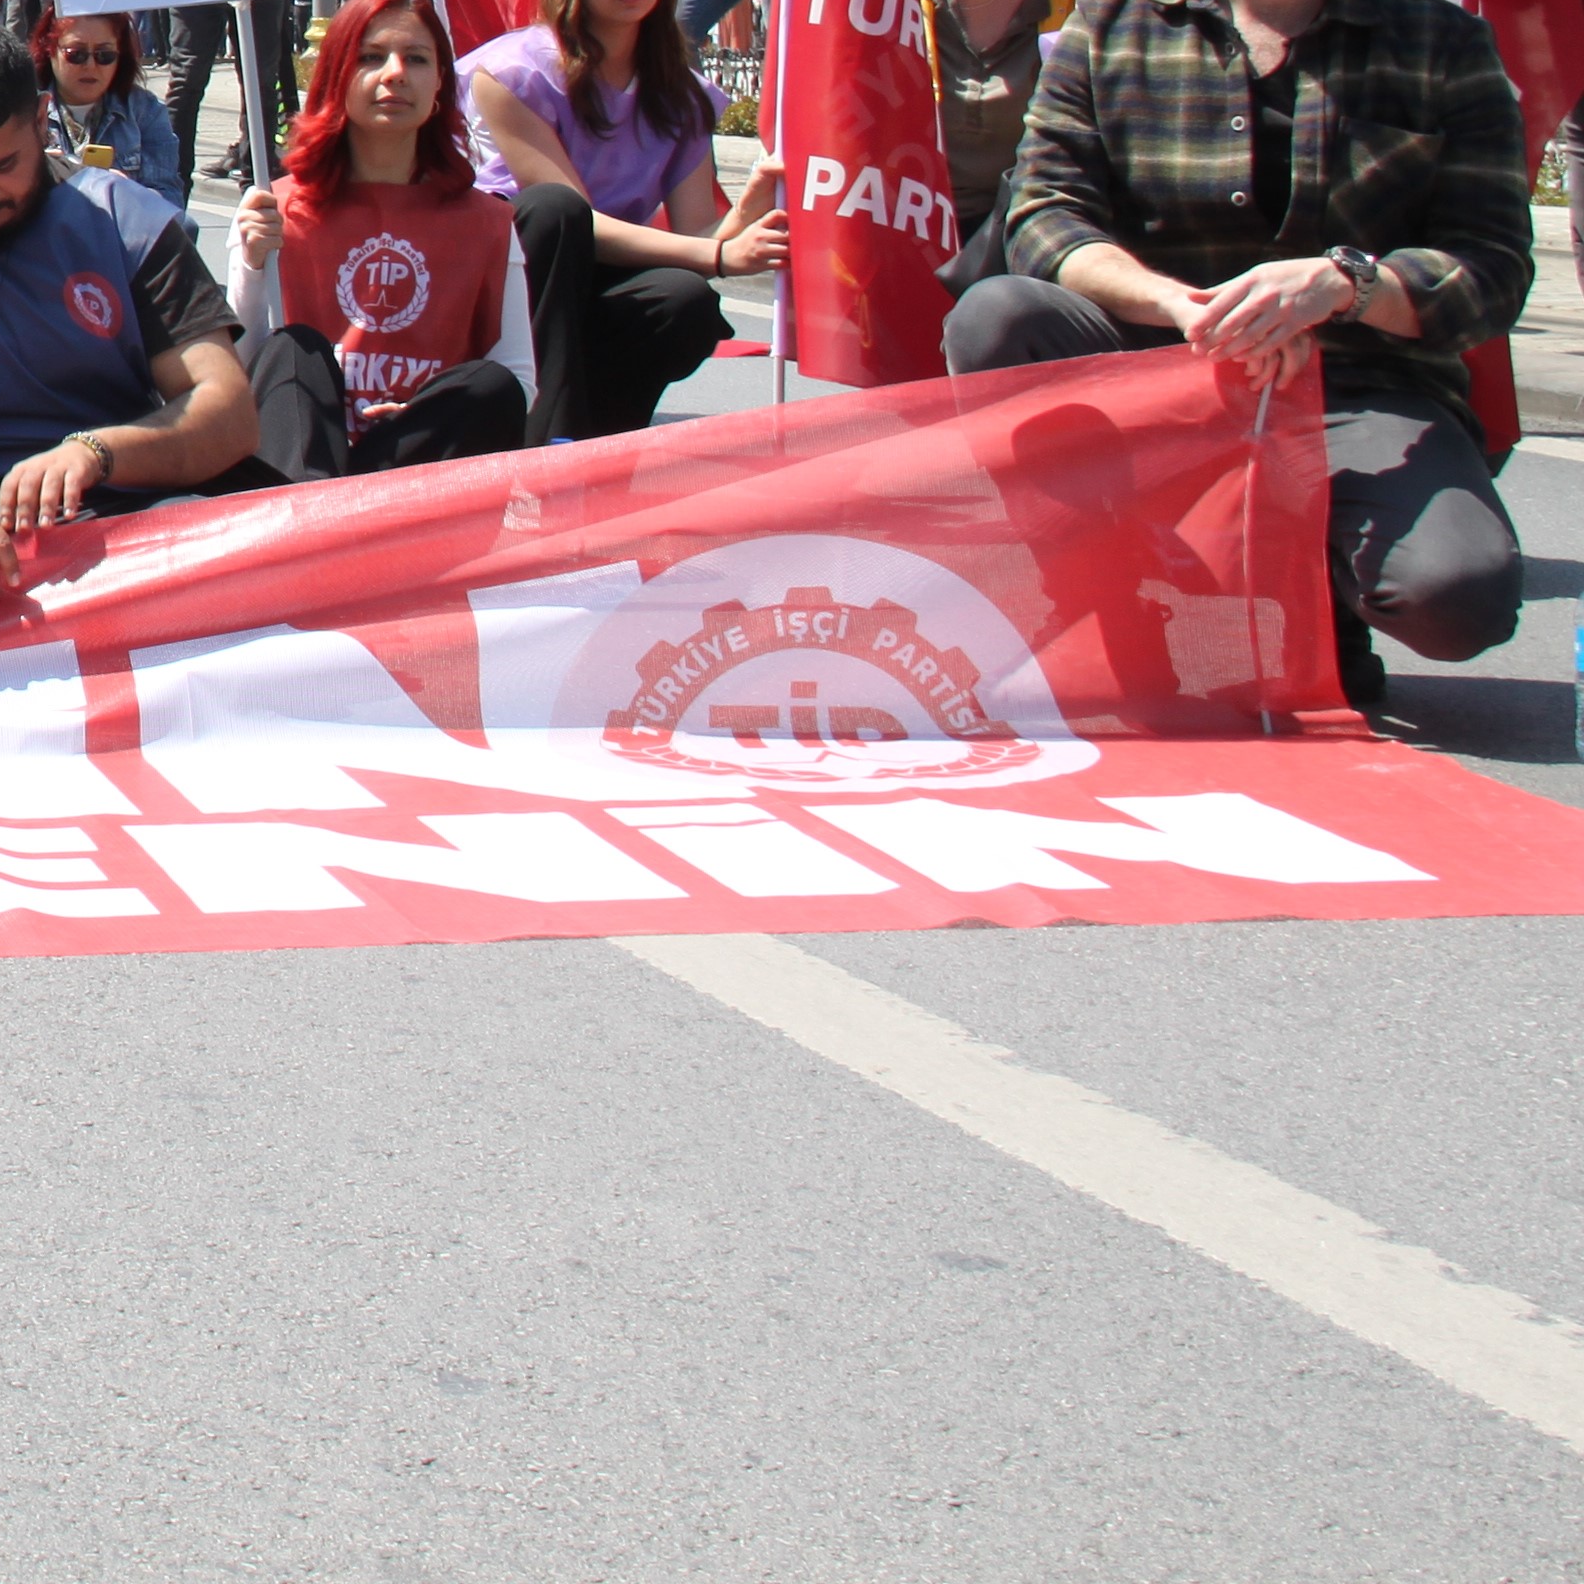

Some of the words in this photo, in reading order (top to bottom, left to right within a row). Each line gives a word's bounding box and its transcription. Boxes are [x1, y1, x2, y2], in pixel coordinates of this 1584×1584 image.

[366, 256, 409, 286] TİP
[632, 625, 750, 736] TÜRKİYE
[772, 607, 849, 644] İŞÇİ
[873, 632, 990, 737] PARTİSİ
